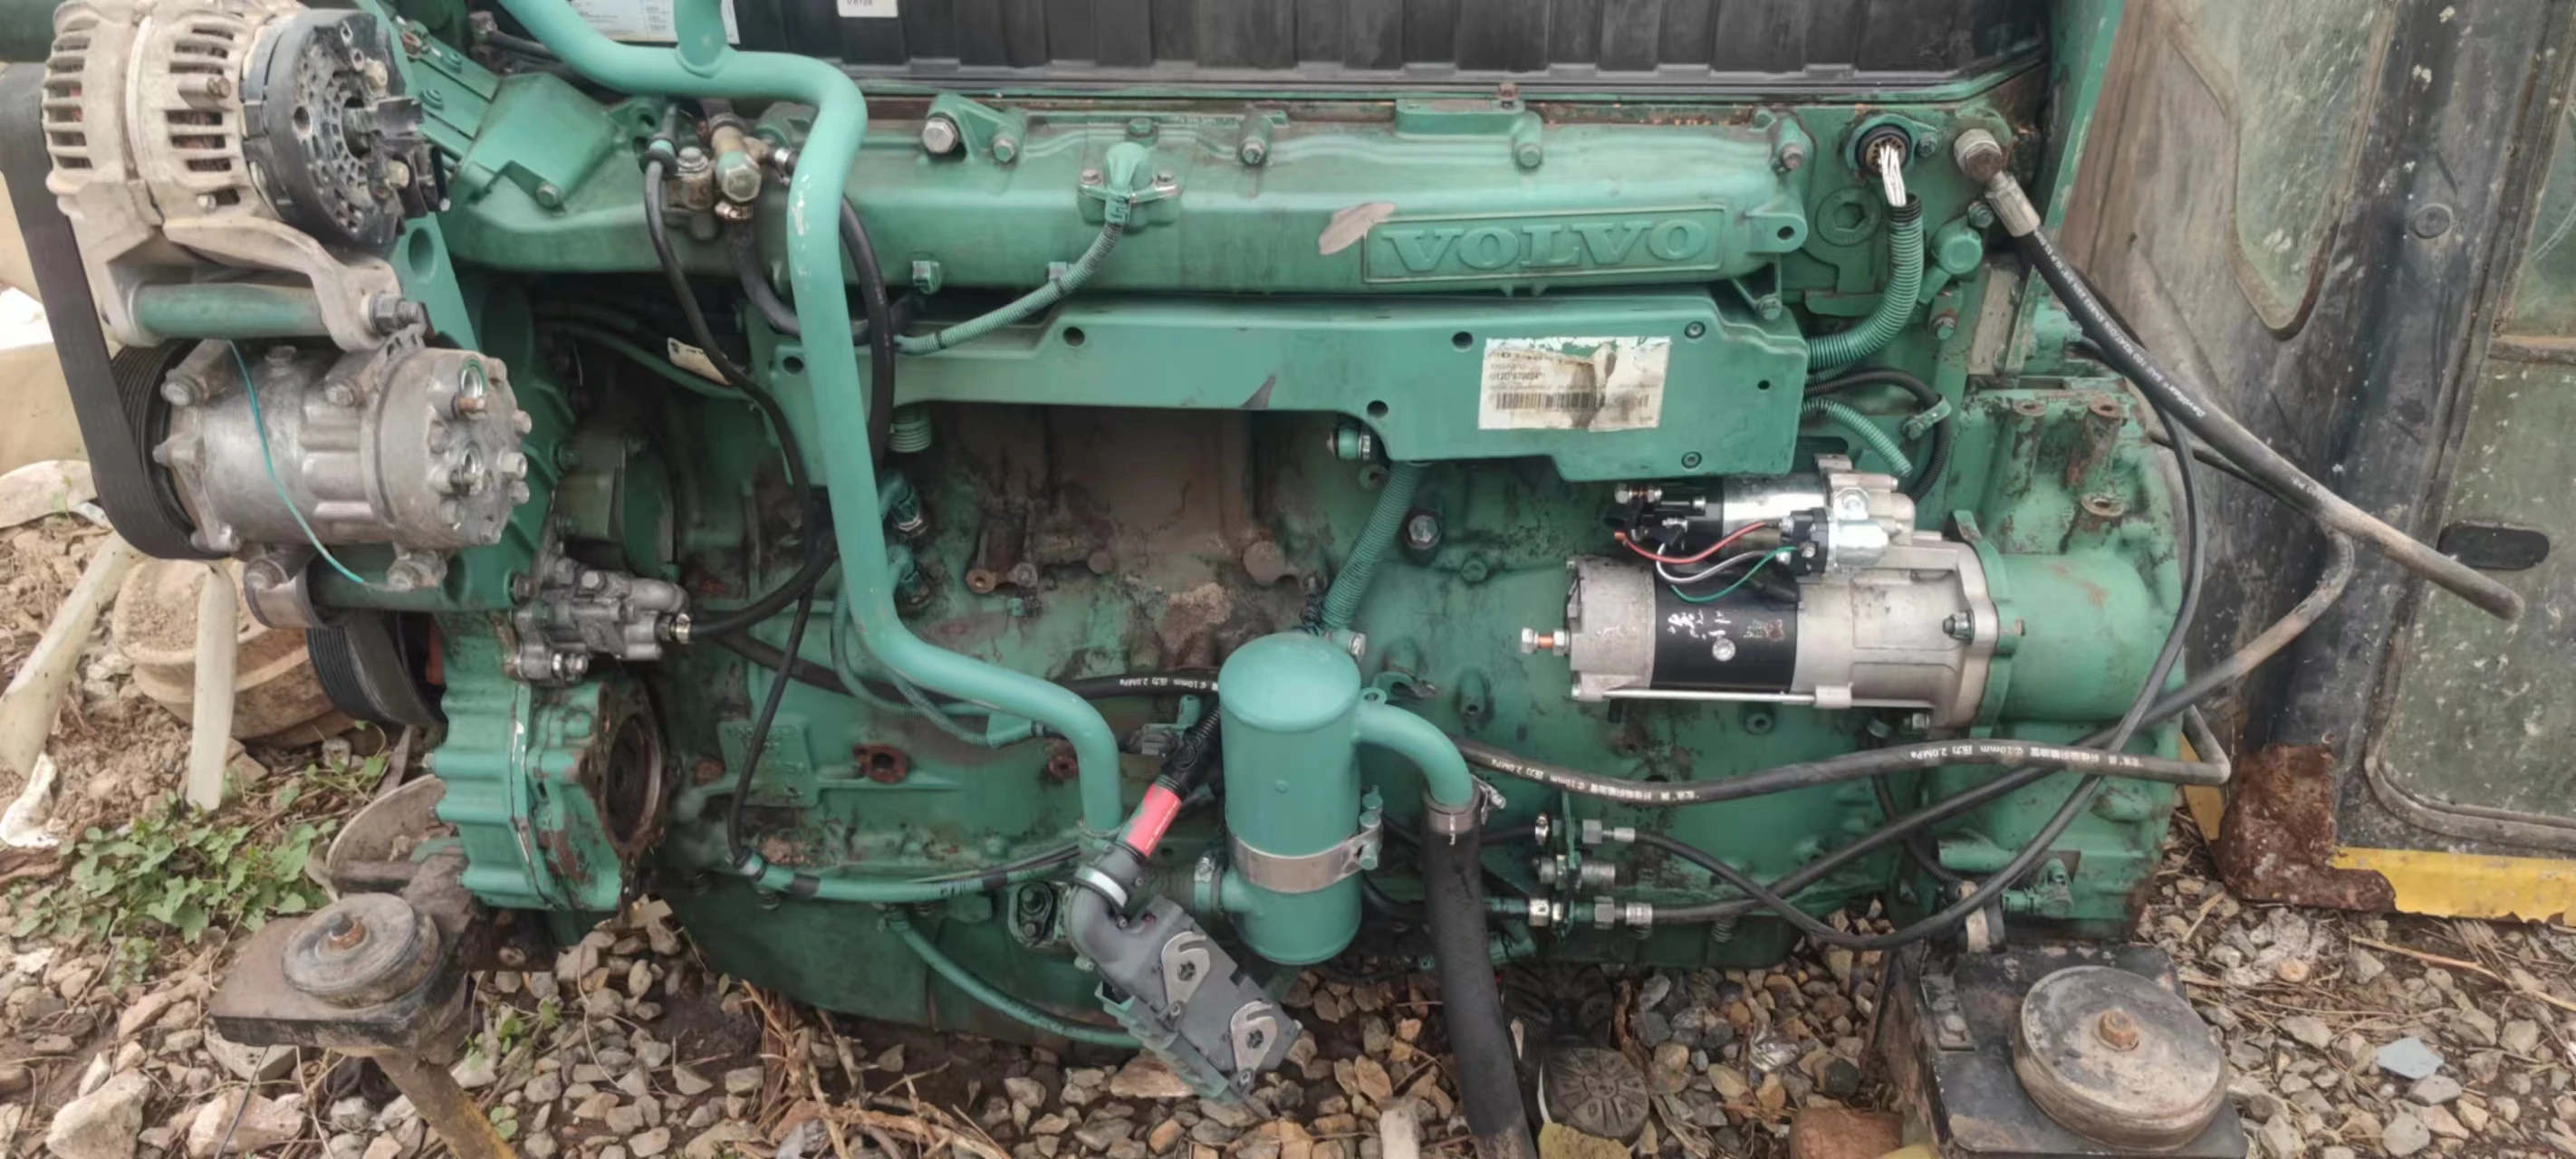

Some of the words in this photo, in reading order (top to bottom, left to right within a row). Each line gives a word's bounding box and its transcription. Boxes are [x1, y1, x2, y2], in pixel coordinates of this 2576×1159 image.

[1381, 218, 1708, 272] VOLVO
[2131, 351, 2147, 368] 100
[1910, 746, 1947, 760] 2.0MPa
[1491, 759, 1523, 774] 2.0MPa
